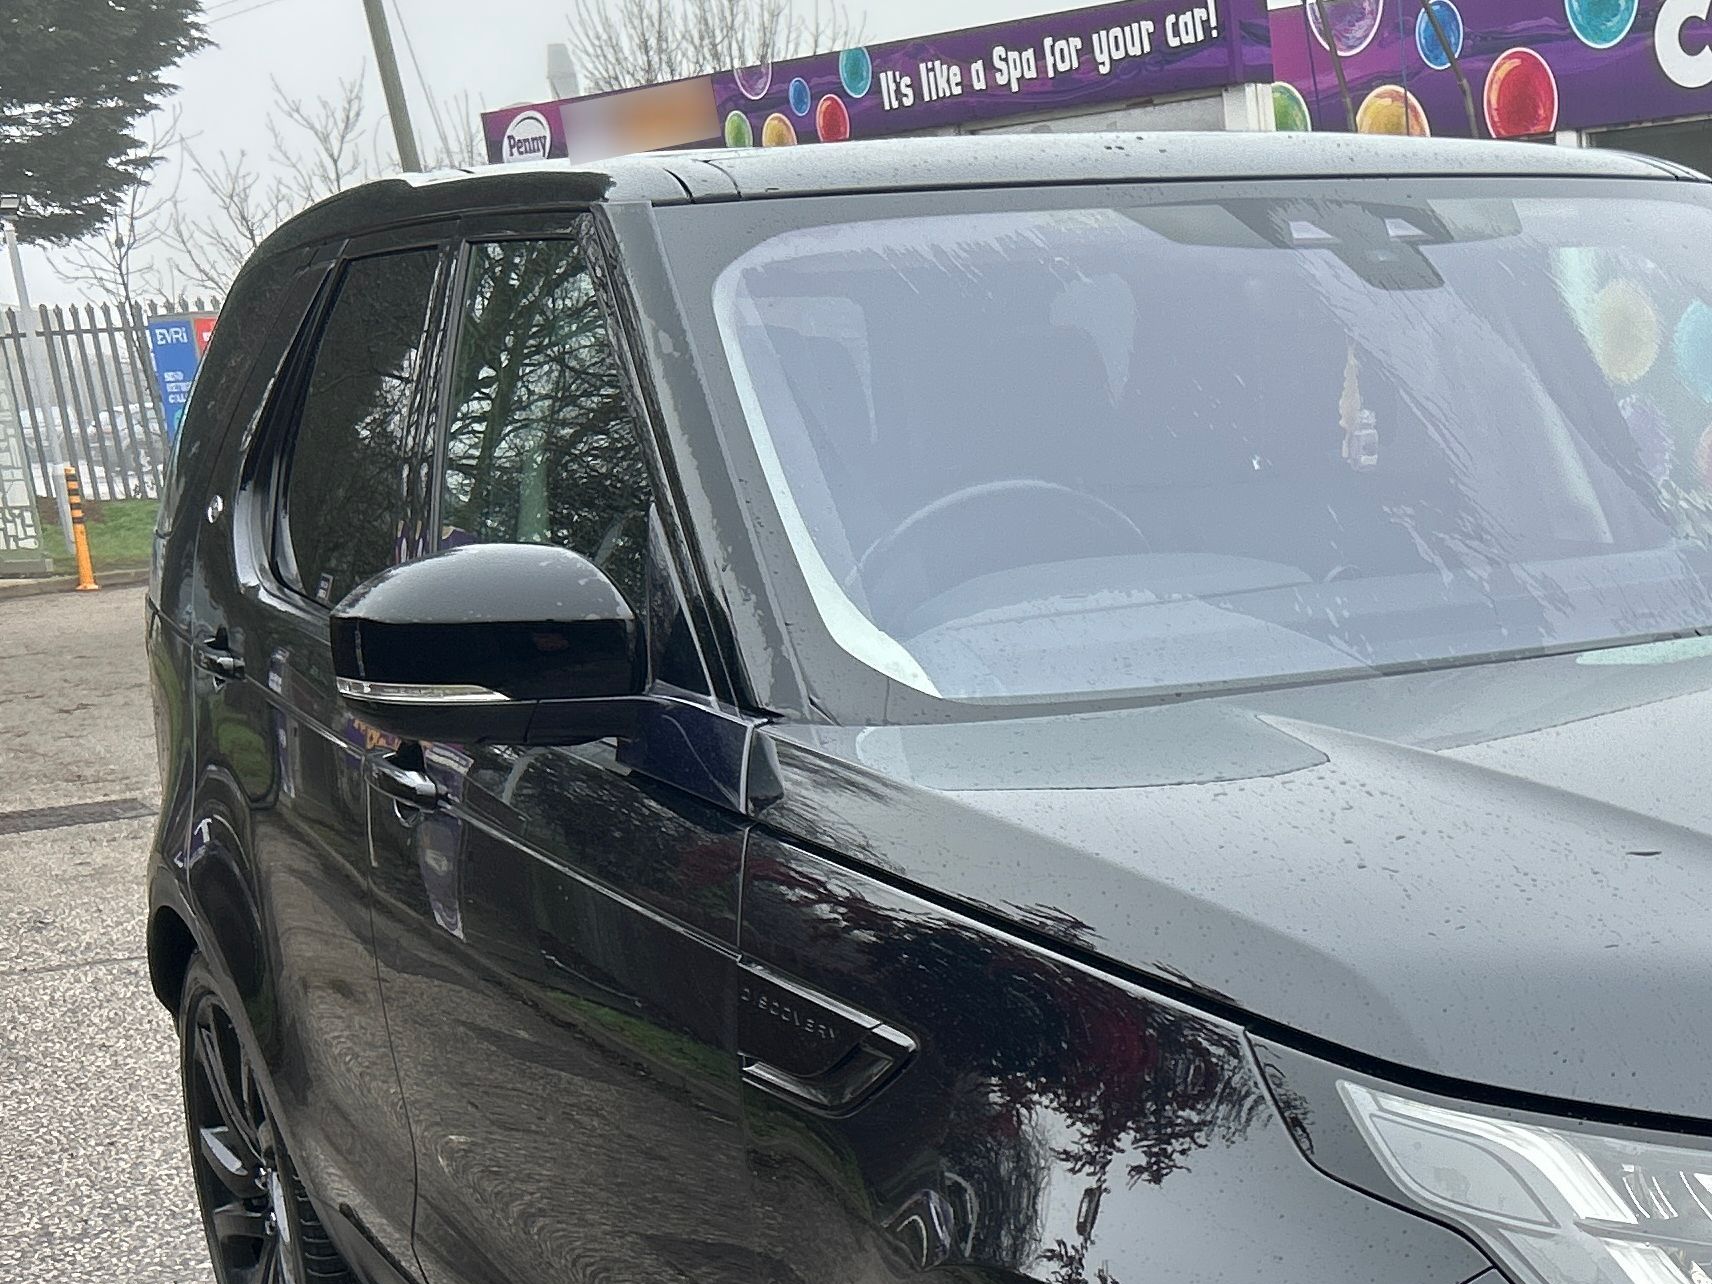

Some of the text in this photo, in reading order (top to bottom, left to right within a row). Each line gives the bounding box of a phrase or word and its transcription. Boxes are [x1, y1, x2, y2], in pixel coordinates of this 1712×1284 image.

[879, 0, 1218, 110] It's like a Spa for your car!
[507, 135, 547, 157] Penny
